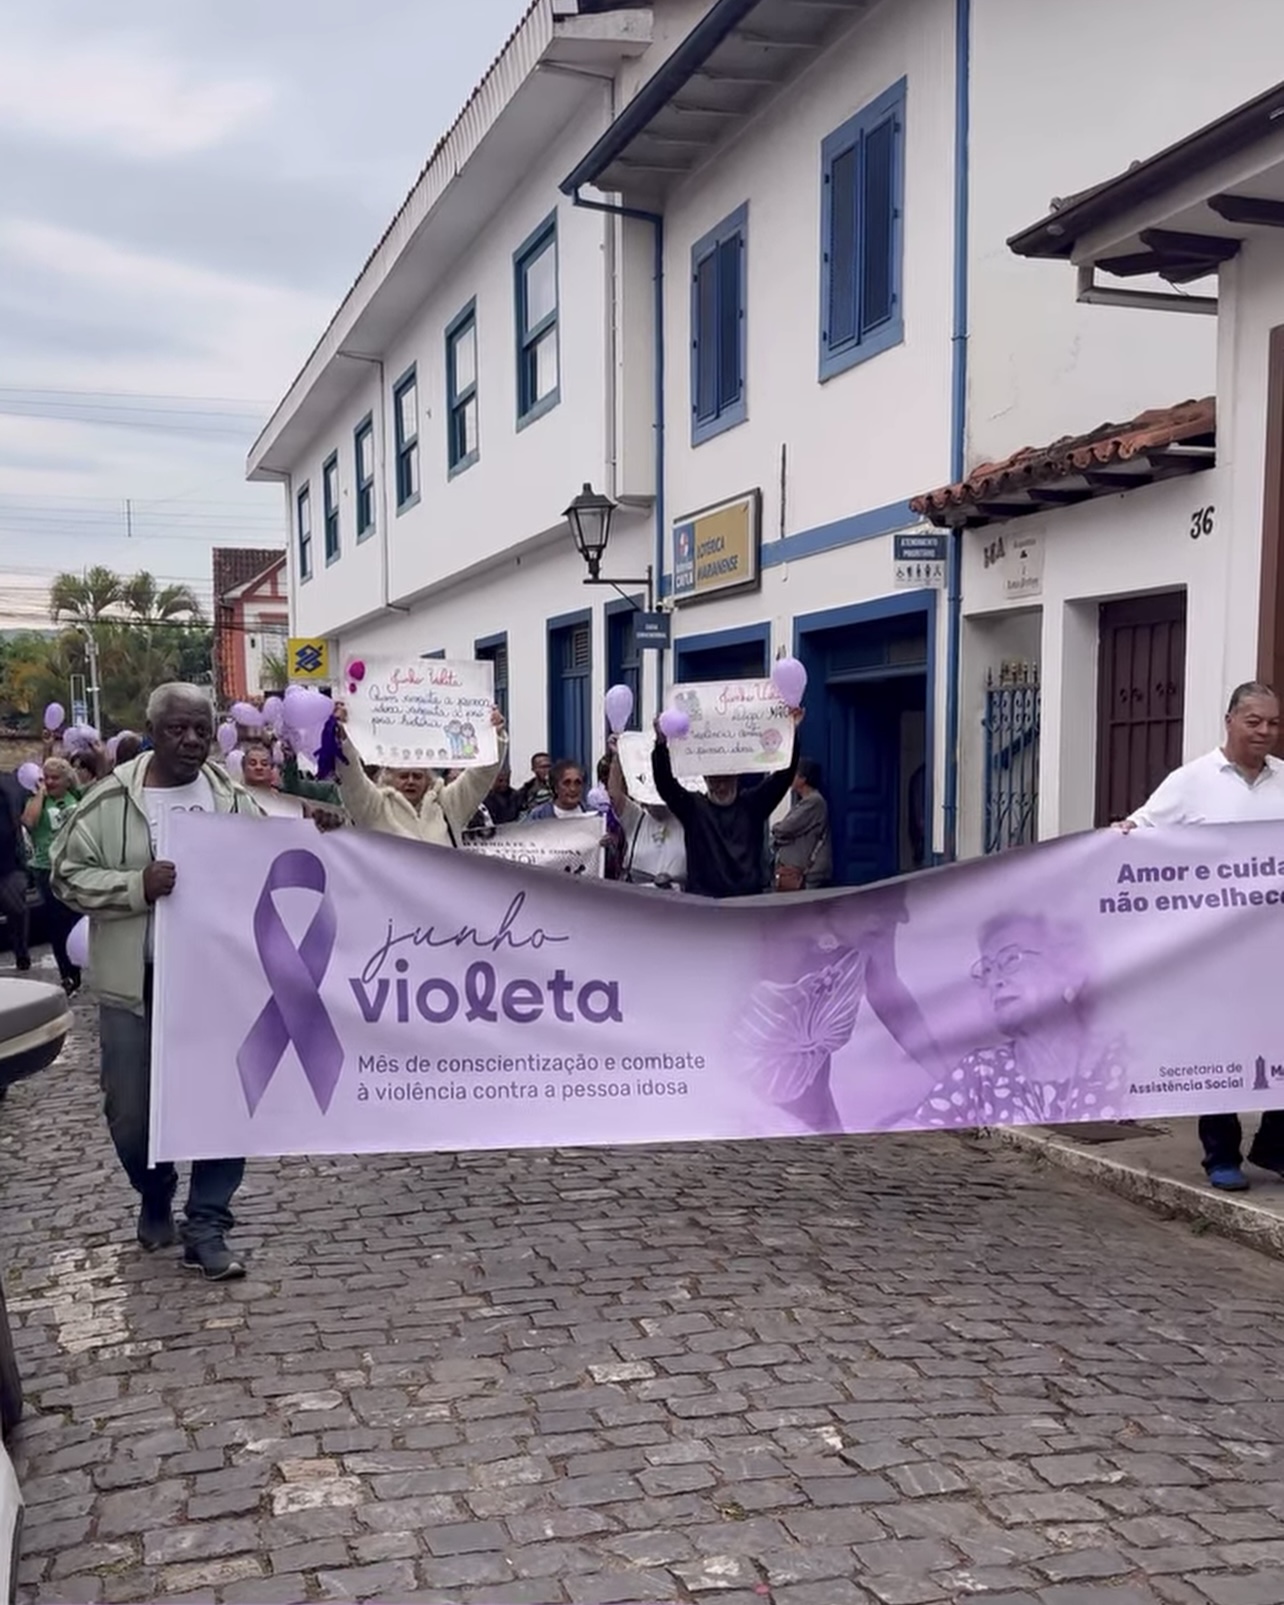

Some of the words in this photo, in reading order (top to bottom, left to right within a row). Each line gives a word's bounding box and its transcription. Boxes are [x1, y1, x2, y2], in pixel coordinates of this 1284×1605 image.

[1190, 505, 1215, 540] 36
[1117, 863, 1189, 883] Amor
[1195, 865, 1211, 880] e
[1100, 891, 1149, 913] não
[362, 890, 570, 984] junho
[349, 958, 623, 1023] violeta
[358, 1055, 400, 1073] Mês
[405, 1055, 431, 1073] de
[436, 1053, 599, 1075] conscientização
[604, 1056, 616, 1071] e
[621, 1052, 705, 1071] combate
[1159, 1064, 1223, 1077] Secretaria
[1226, 1062, 1243, 1073] de
[357, 1083, 369, 1101] à
[375, 1081, 467, 1101] violência
[472, 1081, 538, 1100] contra
[544, 1084, 556, 1098] a
[562, 1083, 631, 1101] pessoa
[636, 1079, 688, 1096] idosa
[1129, 1078, 1203, 1095] Assistência
[1204, 1076, 1243, 1090] Social
